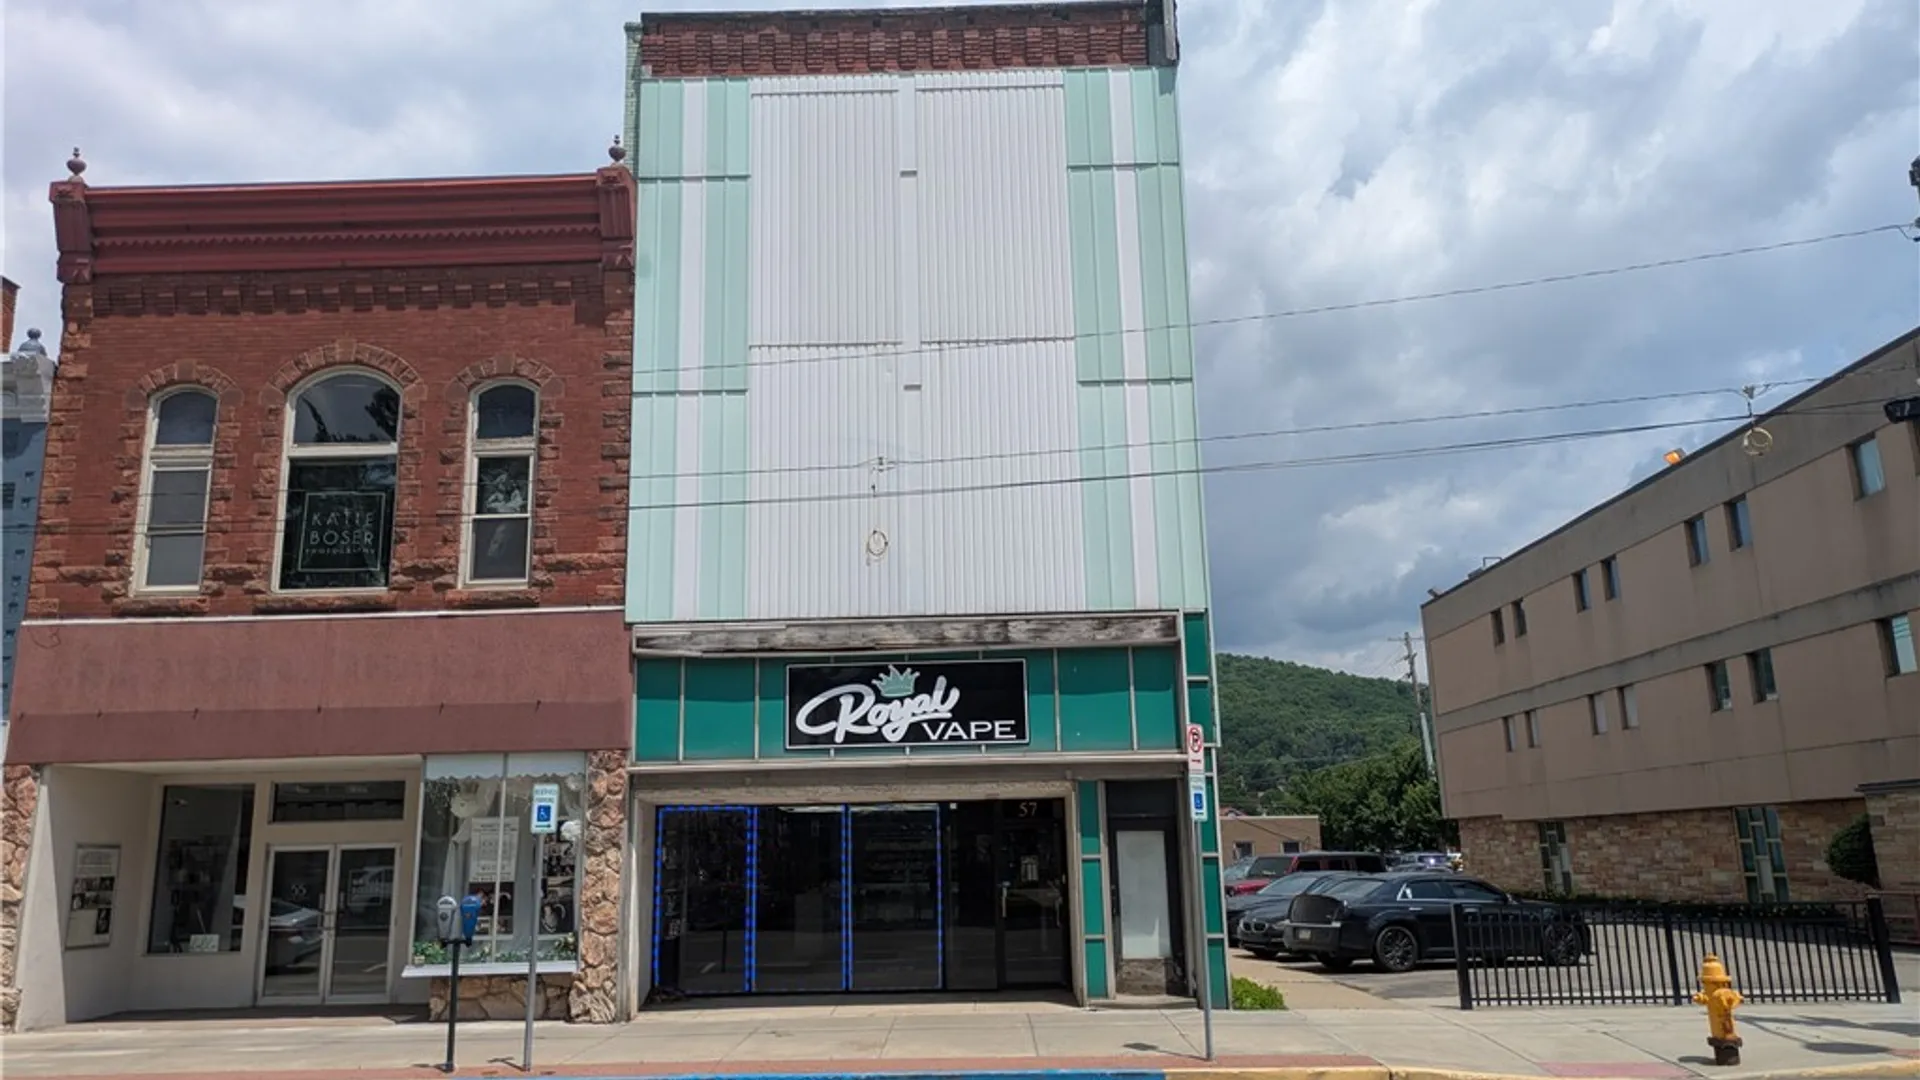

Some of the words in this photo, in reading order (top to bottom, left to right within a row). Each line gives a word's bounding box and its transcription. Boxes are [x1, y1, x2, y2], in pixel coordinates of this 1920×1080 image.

[311, 510, 375, 527] KATIE
[309, 530, 374, 546] BOSER
[795, 675, 961, 744] Royal
[921, 719, 1017, 741] VAPE
[1018, 801, 1038, 818] 57
